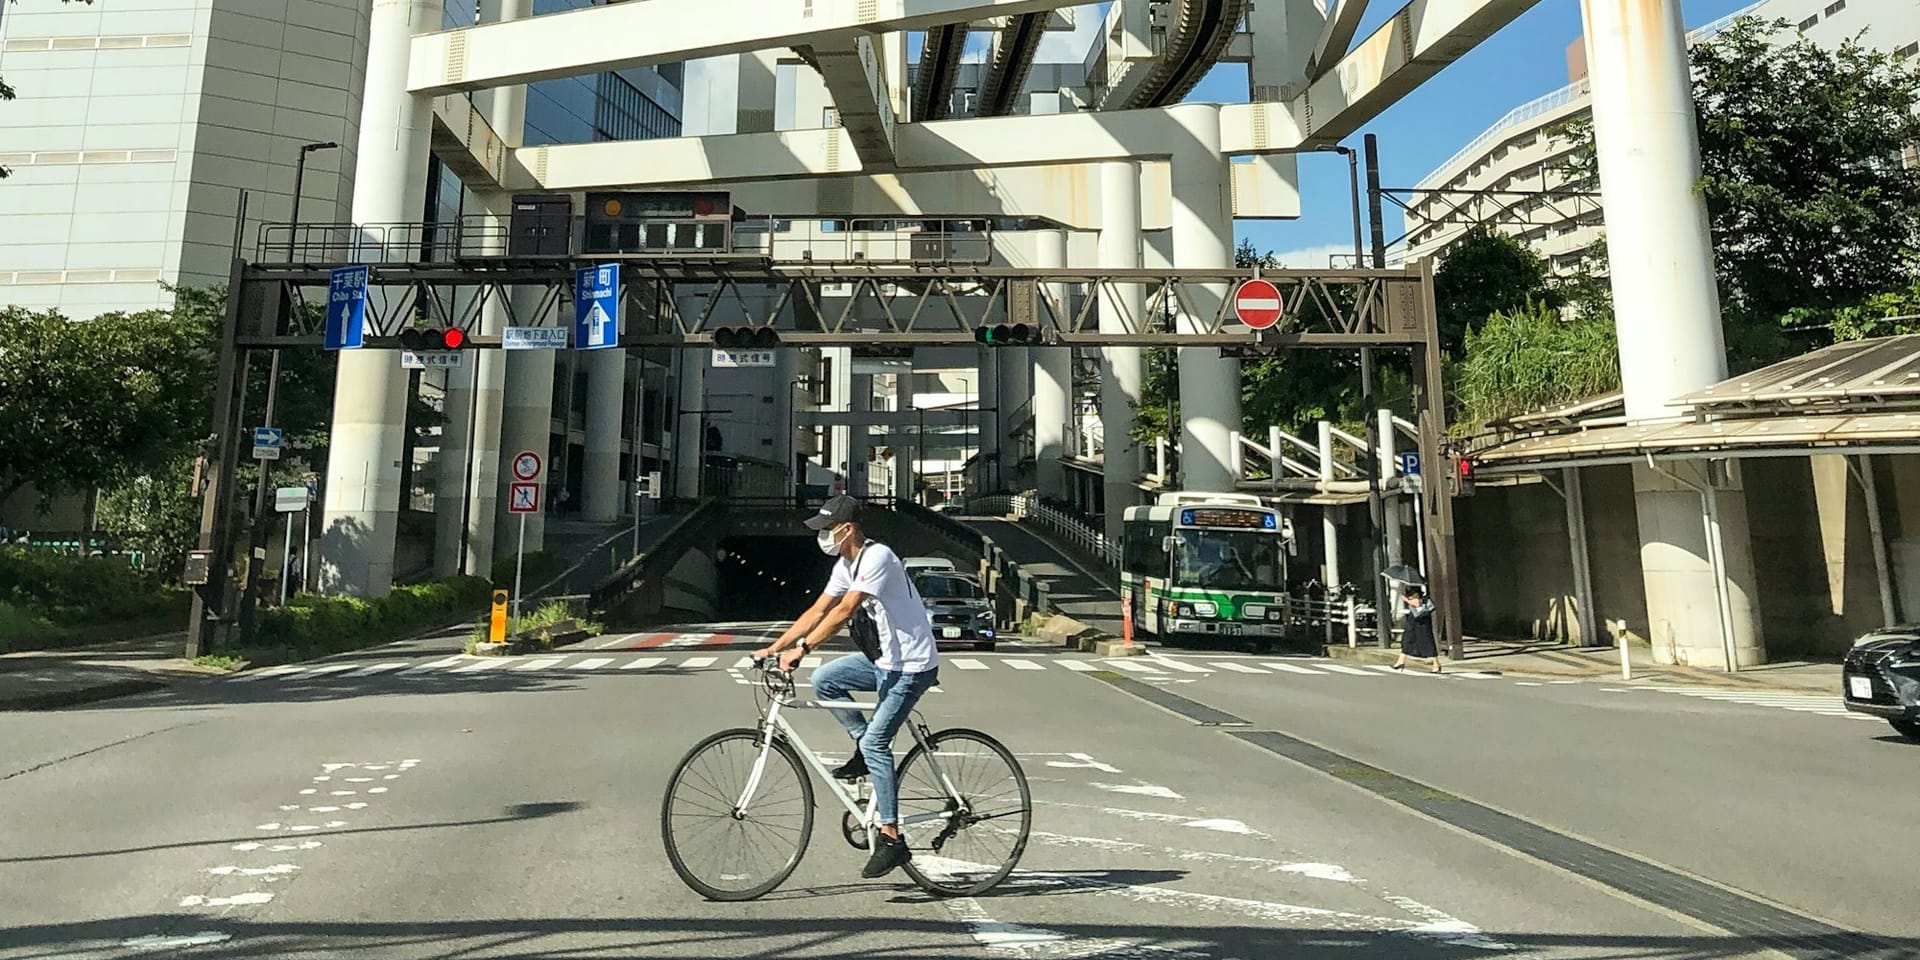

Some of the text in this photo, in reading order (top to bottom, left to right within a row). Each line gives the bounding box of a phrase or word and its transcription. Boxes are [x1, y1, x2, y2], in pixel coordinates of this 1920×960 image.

[333, 271, 365, 290] 千葉駅
[582, 269, 612, 289] 新町
[332, 291, 349, 302] Chiba
[582, 287, 612, 301] Shinmachi
[1406, 455, 1418, 473] P
